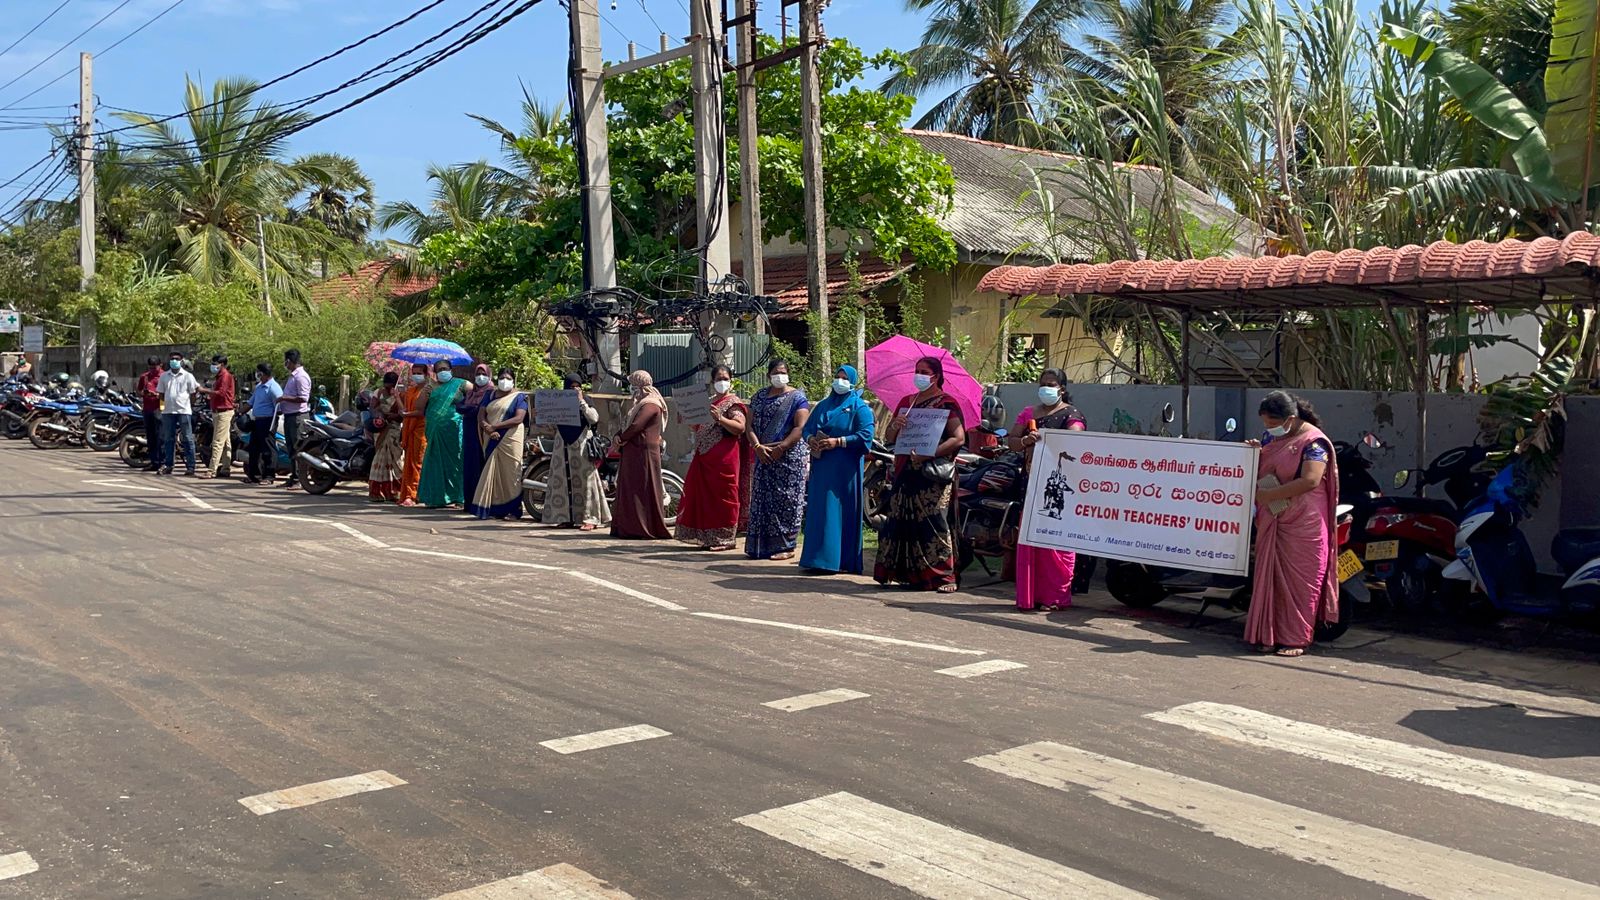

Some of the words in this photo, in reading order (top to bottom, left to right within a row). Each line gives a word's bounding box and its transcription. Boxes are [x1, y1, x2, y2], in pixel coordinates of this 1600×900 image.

[1080, 451, 1137, 469] இலங்கை
[1140, 458, 1195, 475] ஆசிரியர்
[1198, 463, 1244, 479] சங்கம்
[1078, 479, 1119, 494] ලංකා
[1128, 484, 1162, 499] ගුරු
[1171, 487, 1244, 507] සංගමය
[1074, 504, 1119, 520] CEYLON
[1124, 509, 1190, 529] TEACHERS'
[1195, 518, 1240, 534] UNION
